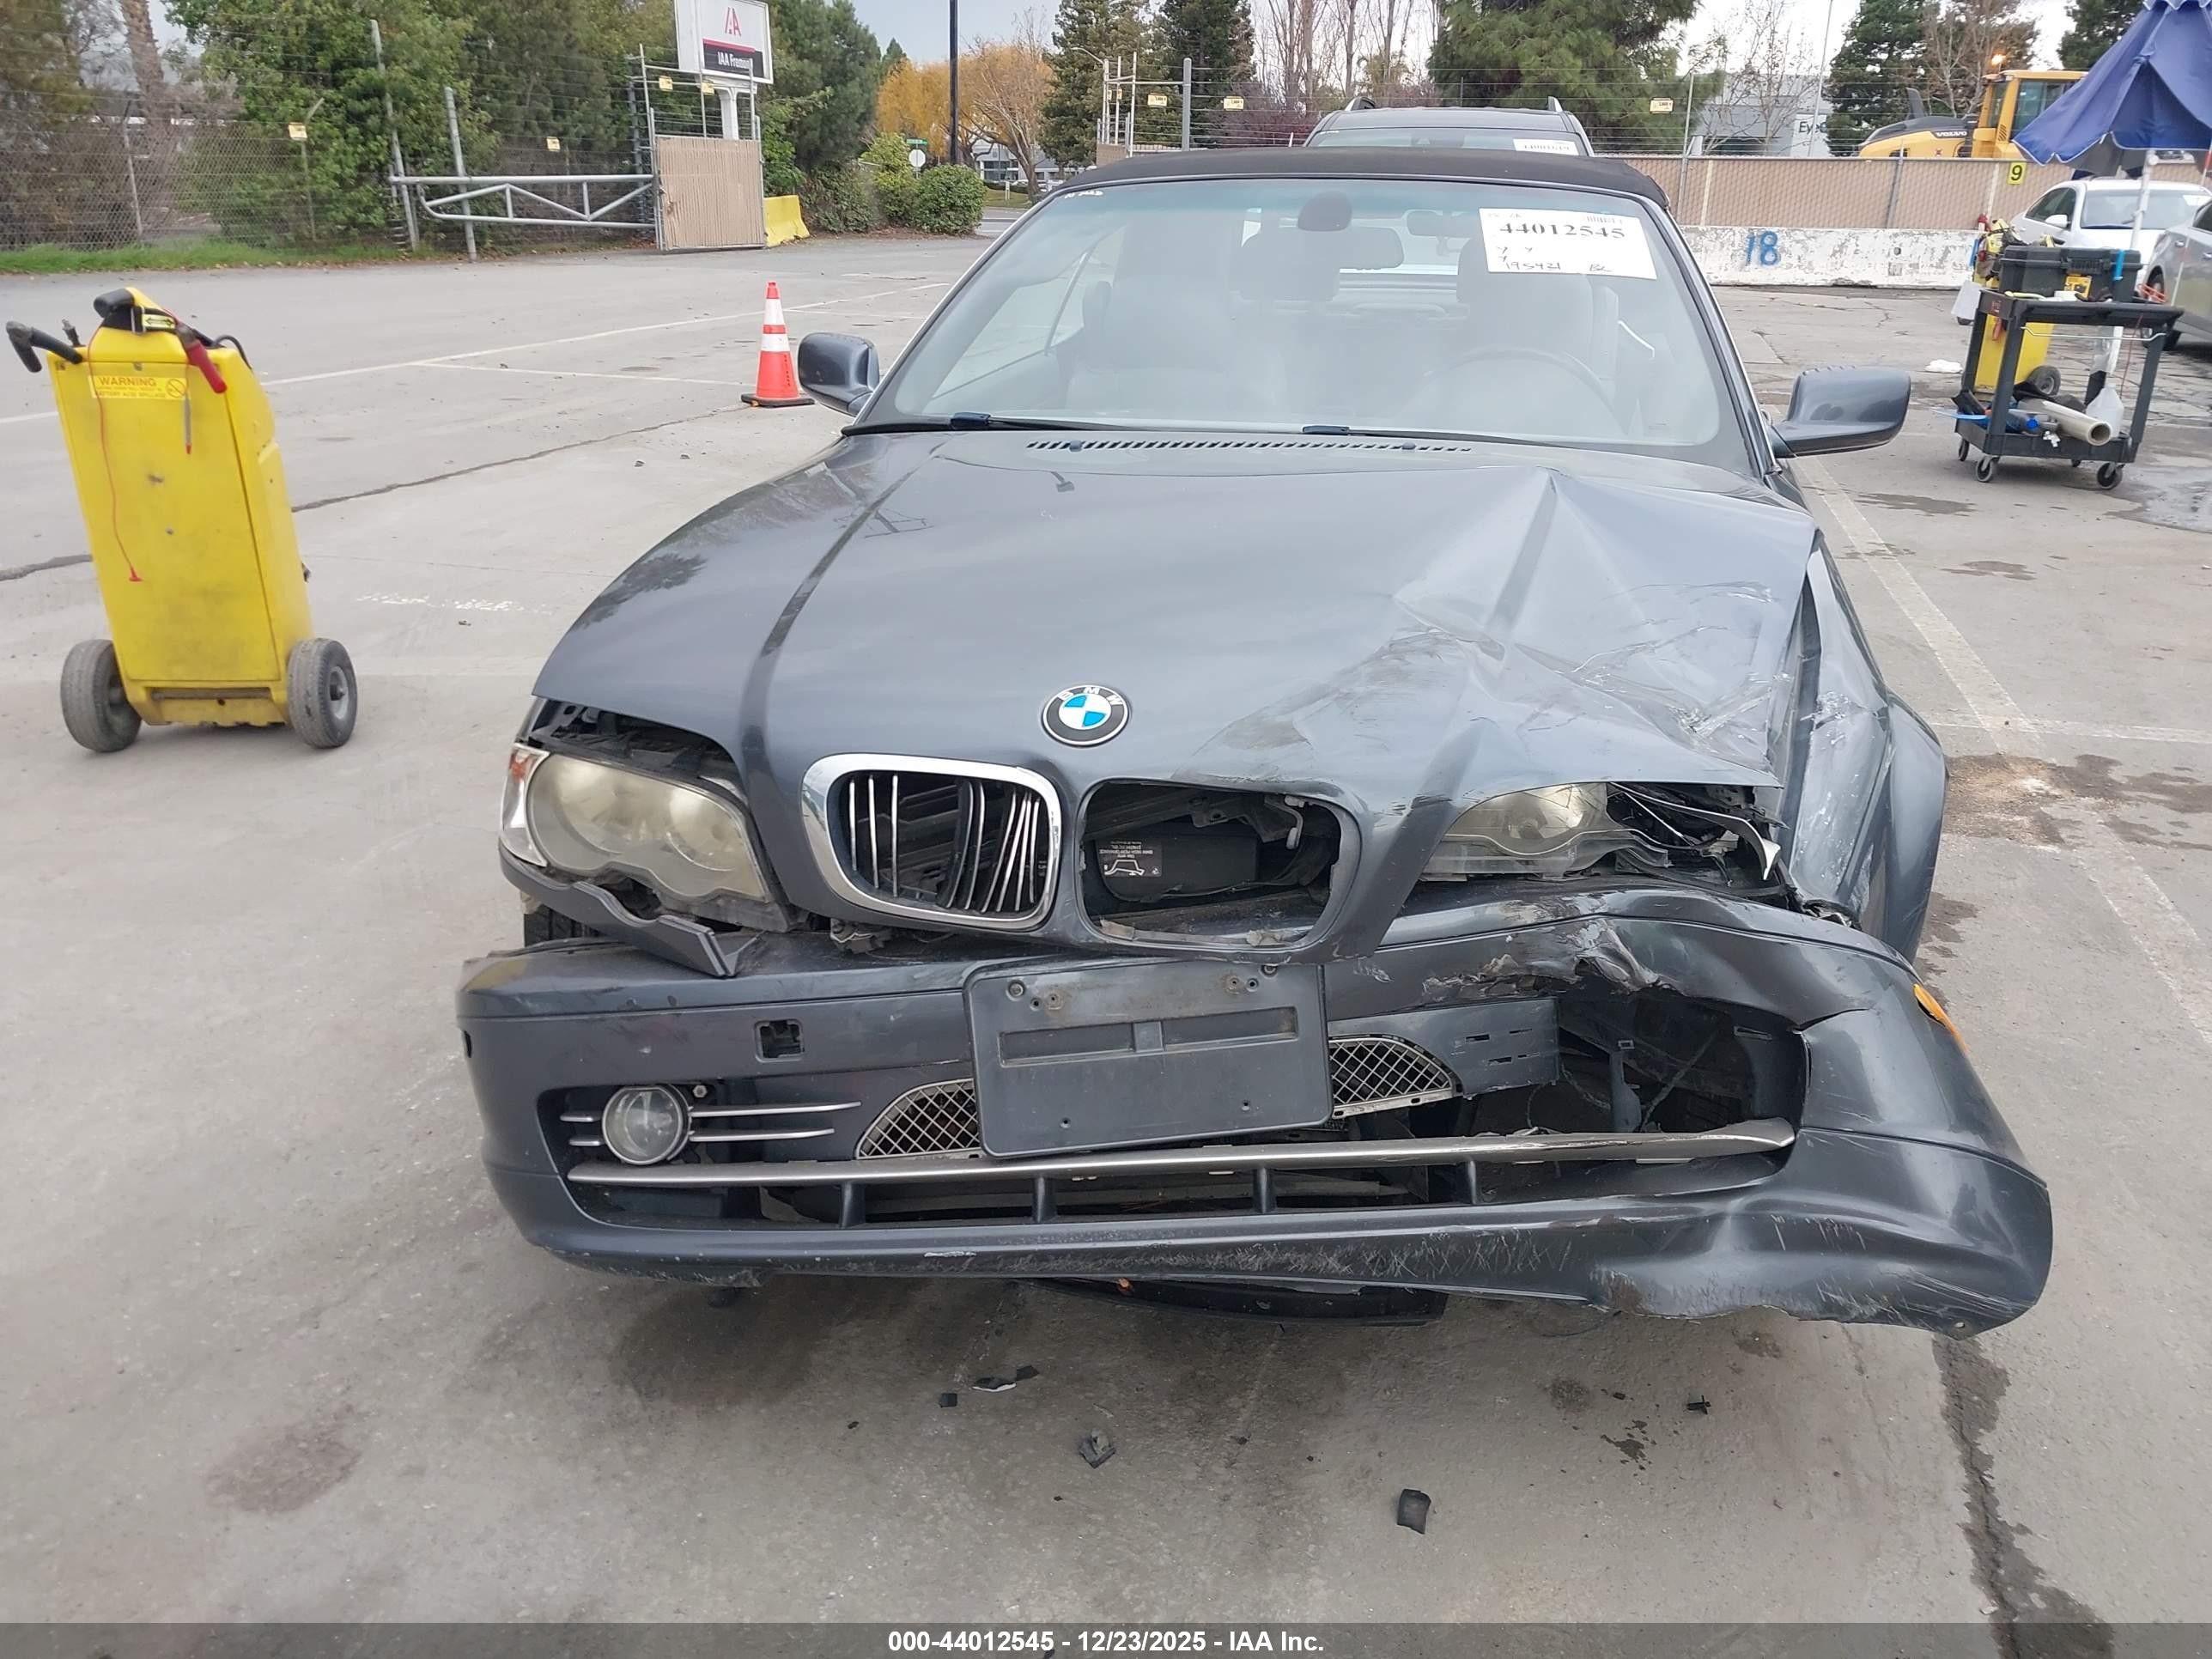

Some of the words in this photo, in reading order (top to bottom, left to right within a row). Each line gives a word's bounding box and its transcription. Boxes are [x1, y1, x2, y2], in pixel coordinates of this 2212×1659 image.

[2010, 164, 2022, 181] 9
[1499, 222, 1625, 239] 44012545
[1745, 231, 1781, 266] 18
[98, 377, 157, 386] WARNING
